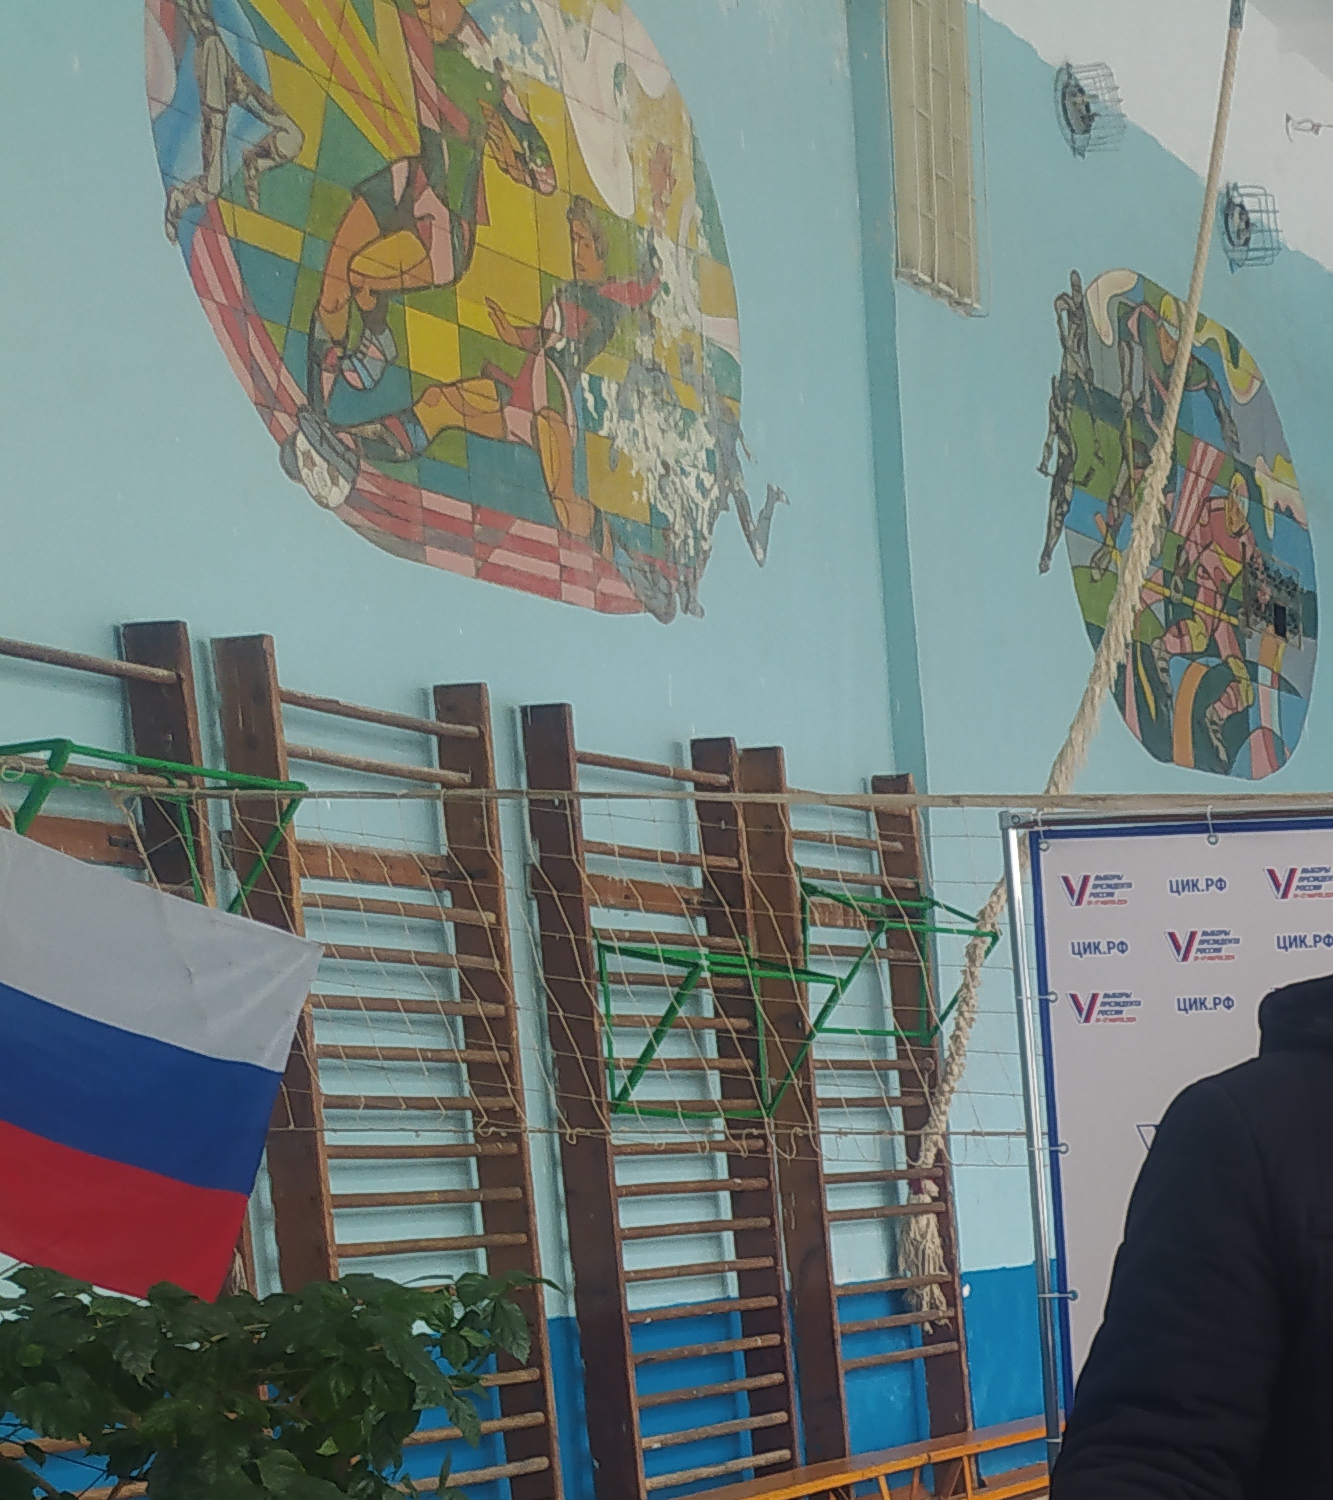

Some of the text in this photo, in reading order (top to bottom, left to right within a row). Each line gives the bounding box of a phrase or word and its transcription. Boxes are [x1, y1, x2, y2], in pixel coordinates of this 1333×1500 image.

[1168, 876, 1227, 897] ЦИК.РФ
[1070, 940, 1129, 959] ЦИК.РФ
[1176, 995, 1235, 1015] ЦИК.РФ
